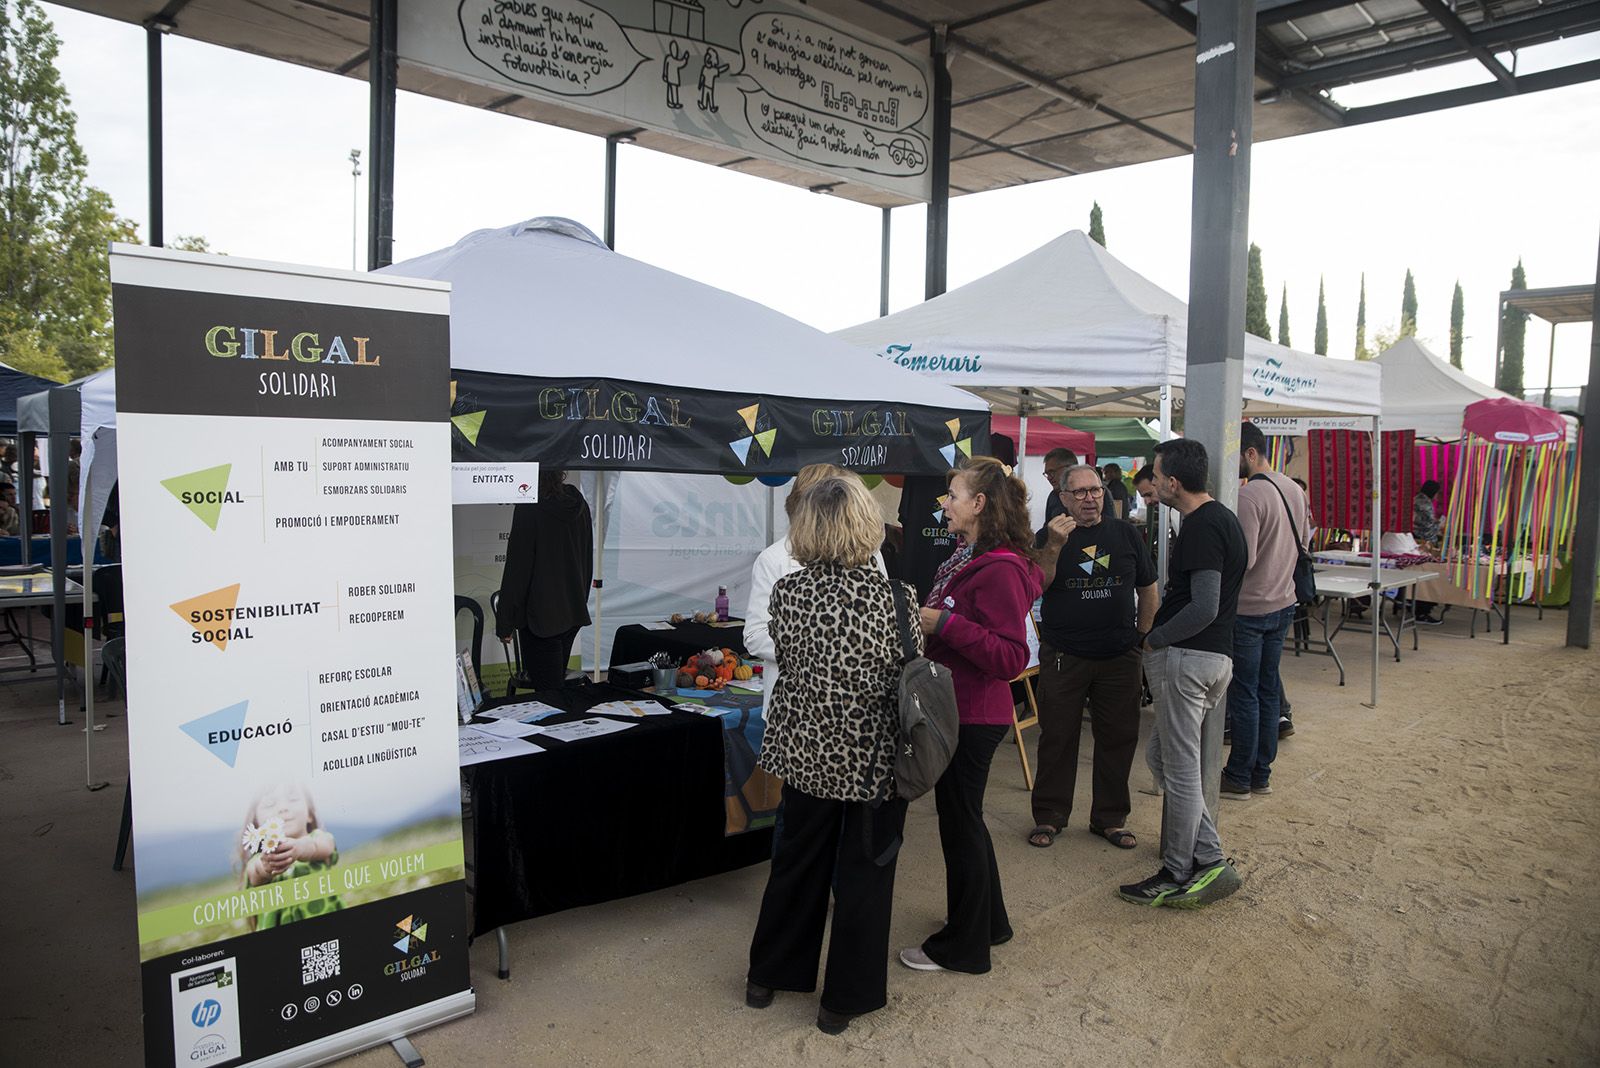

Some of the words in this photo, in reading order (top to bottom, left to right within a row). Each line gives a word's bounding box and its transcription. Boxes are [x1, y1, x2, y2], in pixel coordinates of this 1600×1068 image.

[542, 6, 563, 23] que
[481, 7, 493, 25] al
[549, 24, 563, 41] hi
[564, 27, 583, 46] ha
[583, 37, 608, 53] una
[795, 29, 801, 41] i
[805, 35, 815, 46] a
[817, 37, 836, 53] més
[840, 46, 856, 61] pot
[859, 52, 891, 72] generar
[858, 71, 872, 85] pel
[875, 75, 911, 97] consum
[809, 119, 822, 131] un
[820, 136, 827, 149] 9
[204, 325, 381, 367] GILGAL
[258, 371, 337, 398] SOLIDARI
[538, 387, 692, 429] GILGAL
[812, 408, 915, 437] GILGAL
[1253, 416, 1298, 425] OMNIUM
[322, 438, 387, 449] ACOMPANYAMENT
[389, 439, 414, 450] SOCIAL
[581, 433, 653, 462] SOLIDARI
[842, 446, 889, 467] SOLIDARI
[273, 460, 294, 473] AMB
[296, 461, 309, 473] TU
[322, 462, 352, 472] SUPORT
[354, 462, 410, 472] ADMINISTRATIU
[472, 474, 514, 484] ENTITATS
[181, 490, 245, 505] SOCIAL
[323, 485, 369, 496] ESMORZARS
[370, 484, 407, 495] SOLIDARIS
[275, 515, 323, 529] PROMOCIÓ
[324, 517, 328, 528] I
[330, 513, 400, 528] EMPODERAMENT
[348, 585, 377, 598] ROBER
[378, 582, 416, 596] SOLIDARI
[1081, 588, 1112, 600] SOLIDARI
[190, 601, 321, 624] SOSTENIBILITAT
[349, 609, 405, 625] RECOOPEREM
[191, 626, 254, 644] SOCIAL
[319, 671, 352, 685] REFORÇ
[354, 665, 393, 681] ESCOLAR
[319, 696, 371, 714] ORIENTACIÓ
[373, 690, 420, 707] ACADÈMICA
[207, 718, 293, 746] EDUCACIÓ
[321, 729, 349, 743] CASAL
[351, 724, 385, 739] D'ESTIU
[322, 756, 364, 772] ACOLLIDA
[367, 746, 417, 765] LINGÜÍSTICA
[193, 885, 284, 926] COMPARTIR
[294, 877, 311, 902] ÉS
[318, 875, 335, 896] EL
[343, 866, 372, 890] QUE
[380, 853, 426, 879] VOLEM
[383, 950, 441, 977] GILGAL
[400, 966, 427, 983] SOLIDARI
[193, 999, 220, 1027] hp
[190, 1043, 227, 1061] GILGAL
